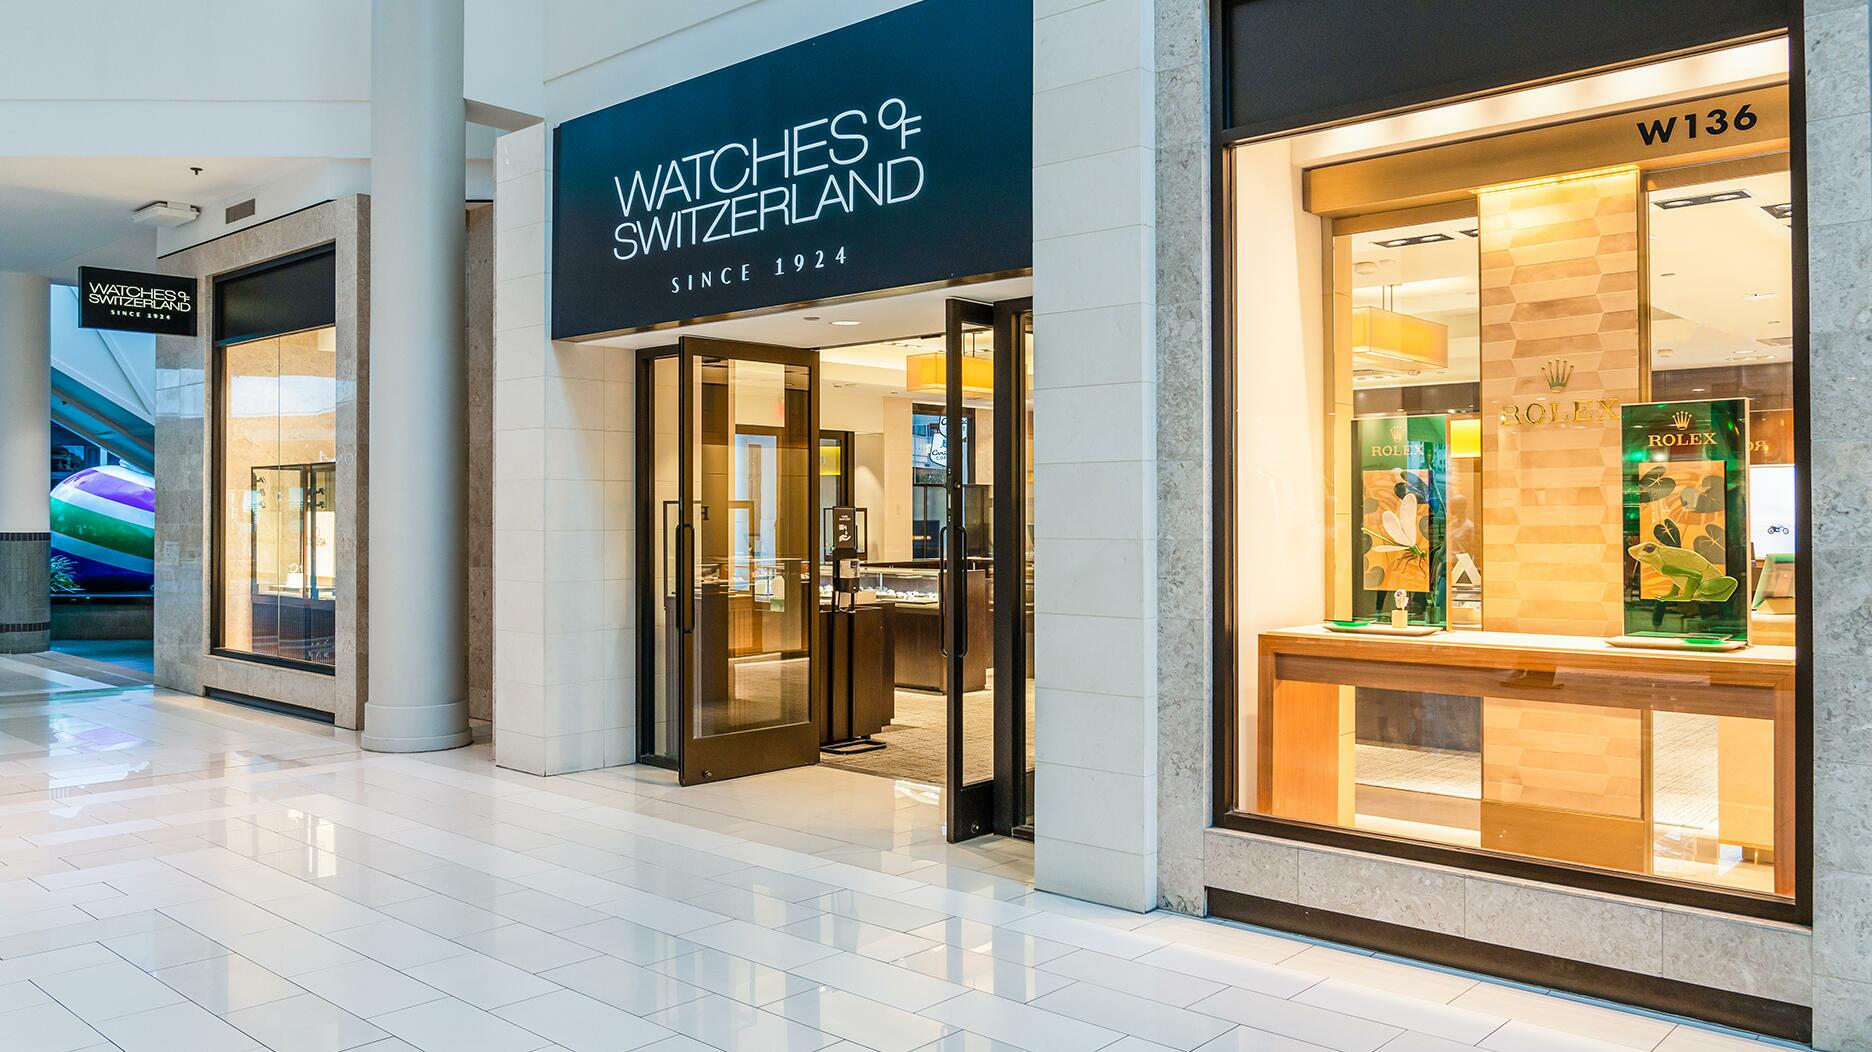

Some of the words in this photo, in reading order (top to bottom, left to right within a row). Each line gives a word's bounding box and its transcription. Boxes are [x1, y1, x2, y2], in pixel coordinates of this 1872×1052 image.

[1636, 104, 1758, 146] W136
[614, 109, 869, 218] WATCHES
[877, 97, 922, 151] OF
[613, 155, 925, 261] SWITZERLAND
[671, 263, 752, 295] SINCE
[774, 246, 848, 277] 1924
[88, 281, 177, 302] WATCHES
[177, 290, 191, 303] OF
[88, 293, 192, 313] SWITZERLAND
[110, 309, 142, 318] SINCE
[146, 312, 171, 320] 1924
[1501, 398, 1621, 425] ROLEX
[1370, 444, 1424, 457] ROLEX
[1647, 432, 1718, 448] ROLEX
